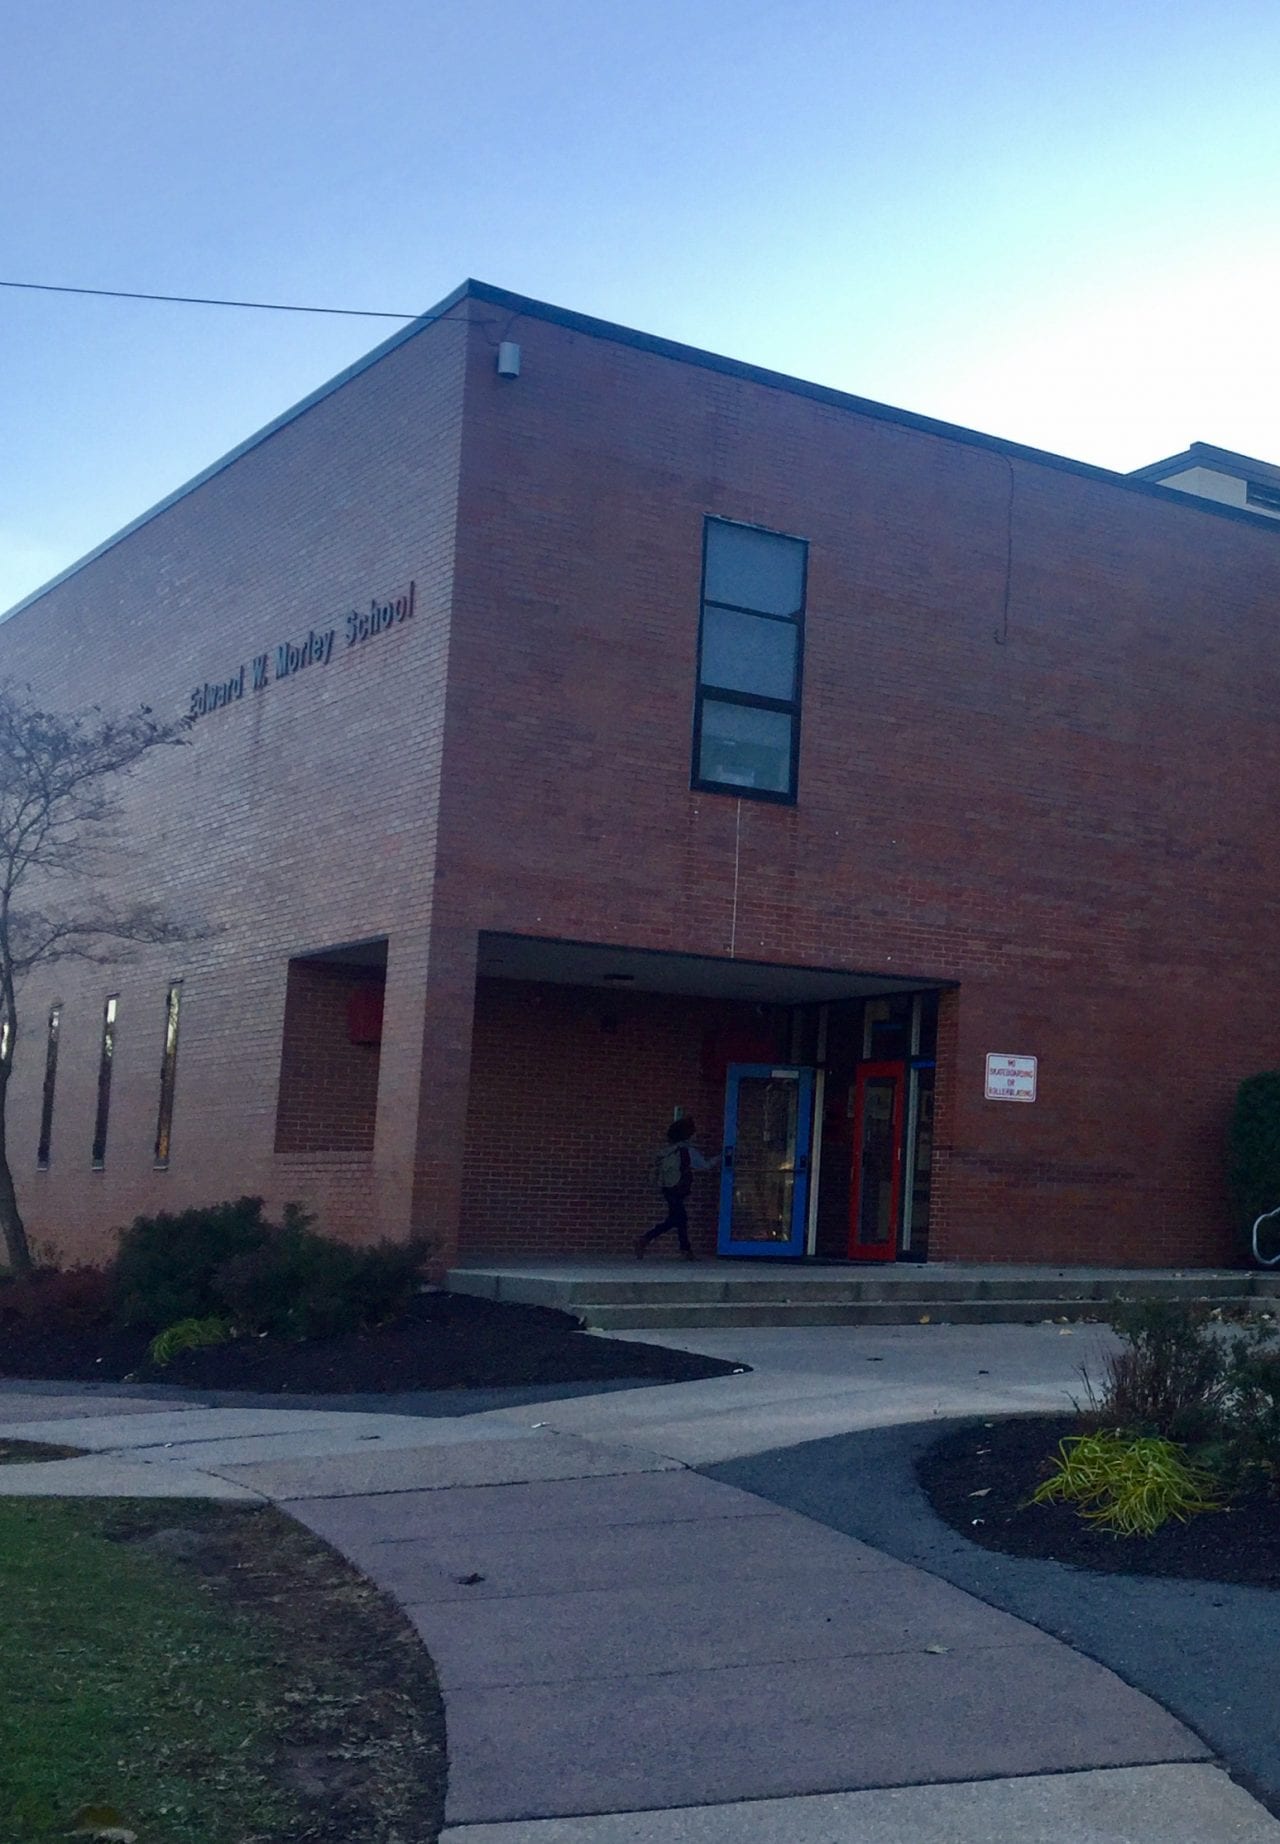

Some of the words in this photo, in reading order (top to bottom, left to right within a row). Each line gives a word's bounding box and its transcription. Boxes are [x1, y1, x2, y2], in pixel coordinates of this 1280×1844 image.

[190, 664, 244, 716] Edward
[252, 653, 268, 690] W.
[275, 630, 335, 680] Morley
[345, 580, 415, 647] School
